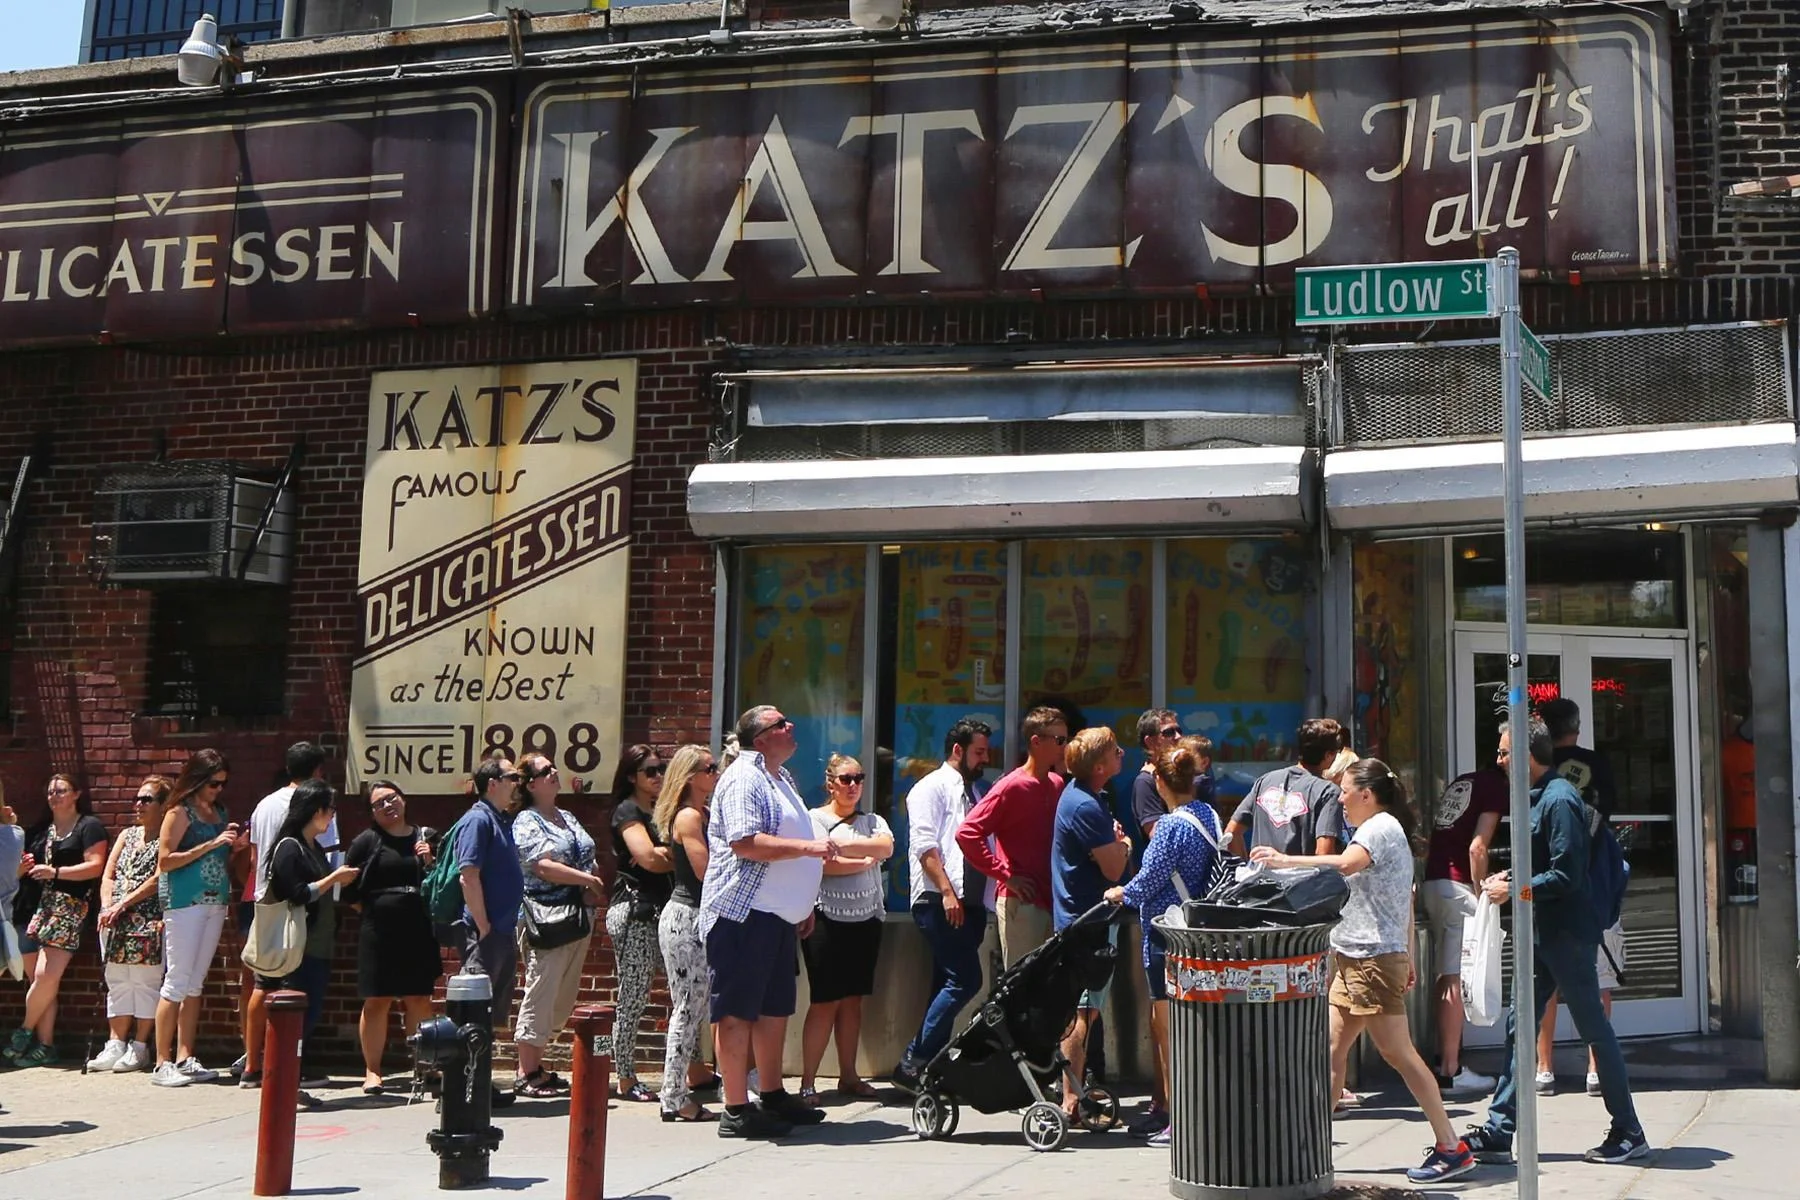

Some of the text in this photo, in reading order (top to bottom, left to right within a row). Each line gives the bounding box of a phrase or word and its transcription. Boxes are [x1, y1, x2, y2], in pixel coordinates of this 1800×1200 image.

[1361, 72, 1592, 182] That's
[541, 91, 1333, 288] KATZ'S
[0, 221, 404, 302] LICATESSEN
[1304, 268, 1483, 316] Ludlow St
[377, 377, 621, 452] KATZ'S
[364, 485, 621, 648] DELICATESSEN
[464, 620, 595, 656] KNOWN
[390, 661, 575, 703] as the Best
[1527, 682, 1559, 698] RANK
[363, 744, 455, 775] SINCE
